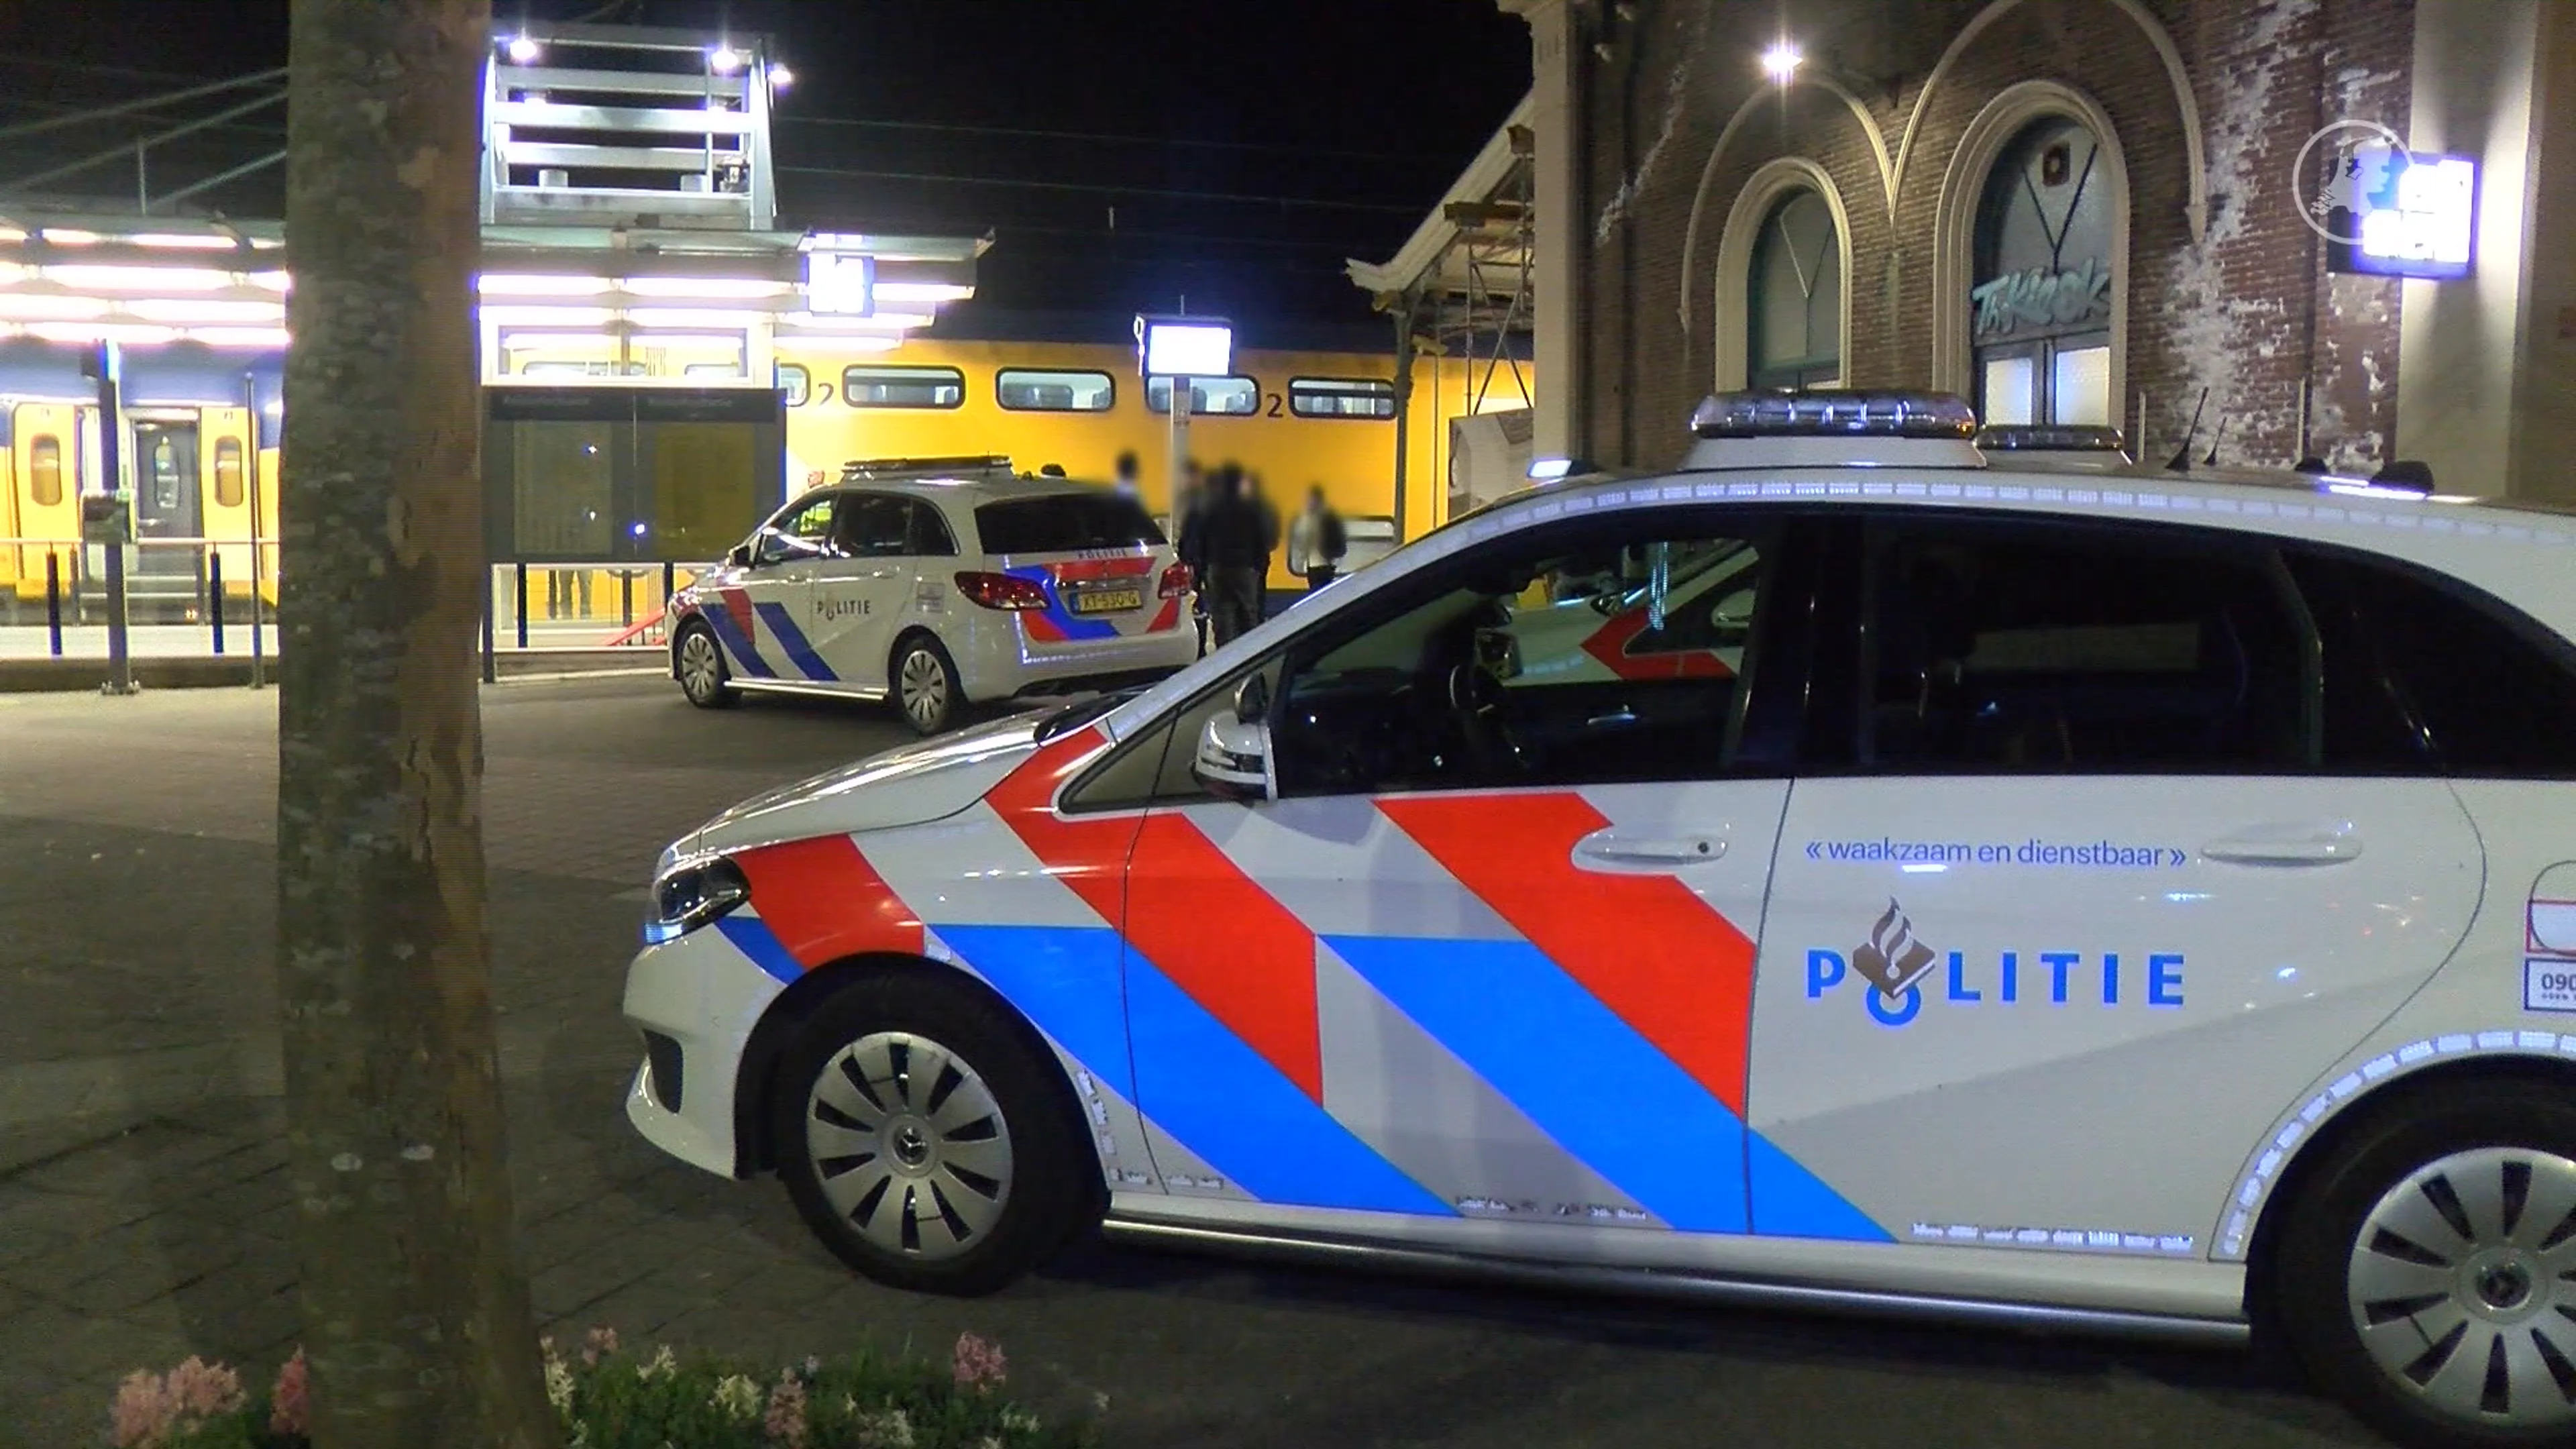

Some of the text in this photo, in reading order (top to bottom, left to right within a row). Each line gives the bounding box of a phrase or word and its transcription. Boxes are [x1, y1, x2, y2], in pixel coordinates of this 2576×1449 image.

[818, 382, 834, 407] 2
[1267, 393, 1283, 418] 2
[817, 600, 870, 621] POLITIE
[1827, 837, 1971, 861] waakzaam
[1978, 844, 2010, 863] en
[2017, 839, 2163, 866] dienstbaar
[1807, 949, 2185, 1026] POLITIE
